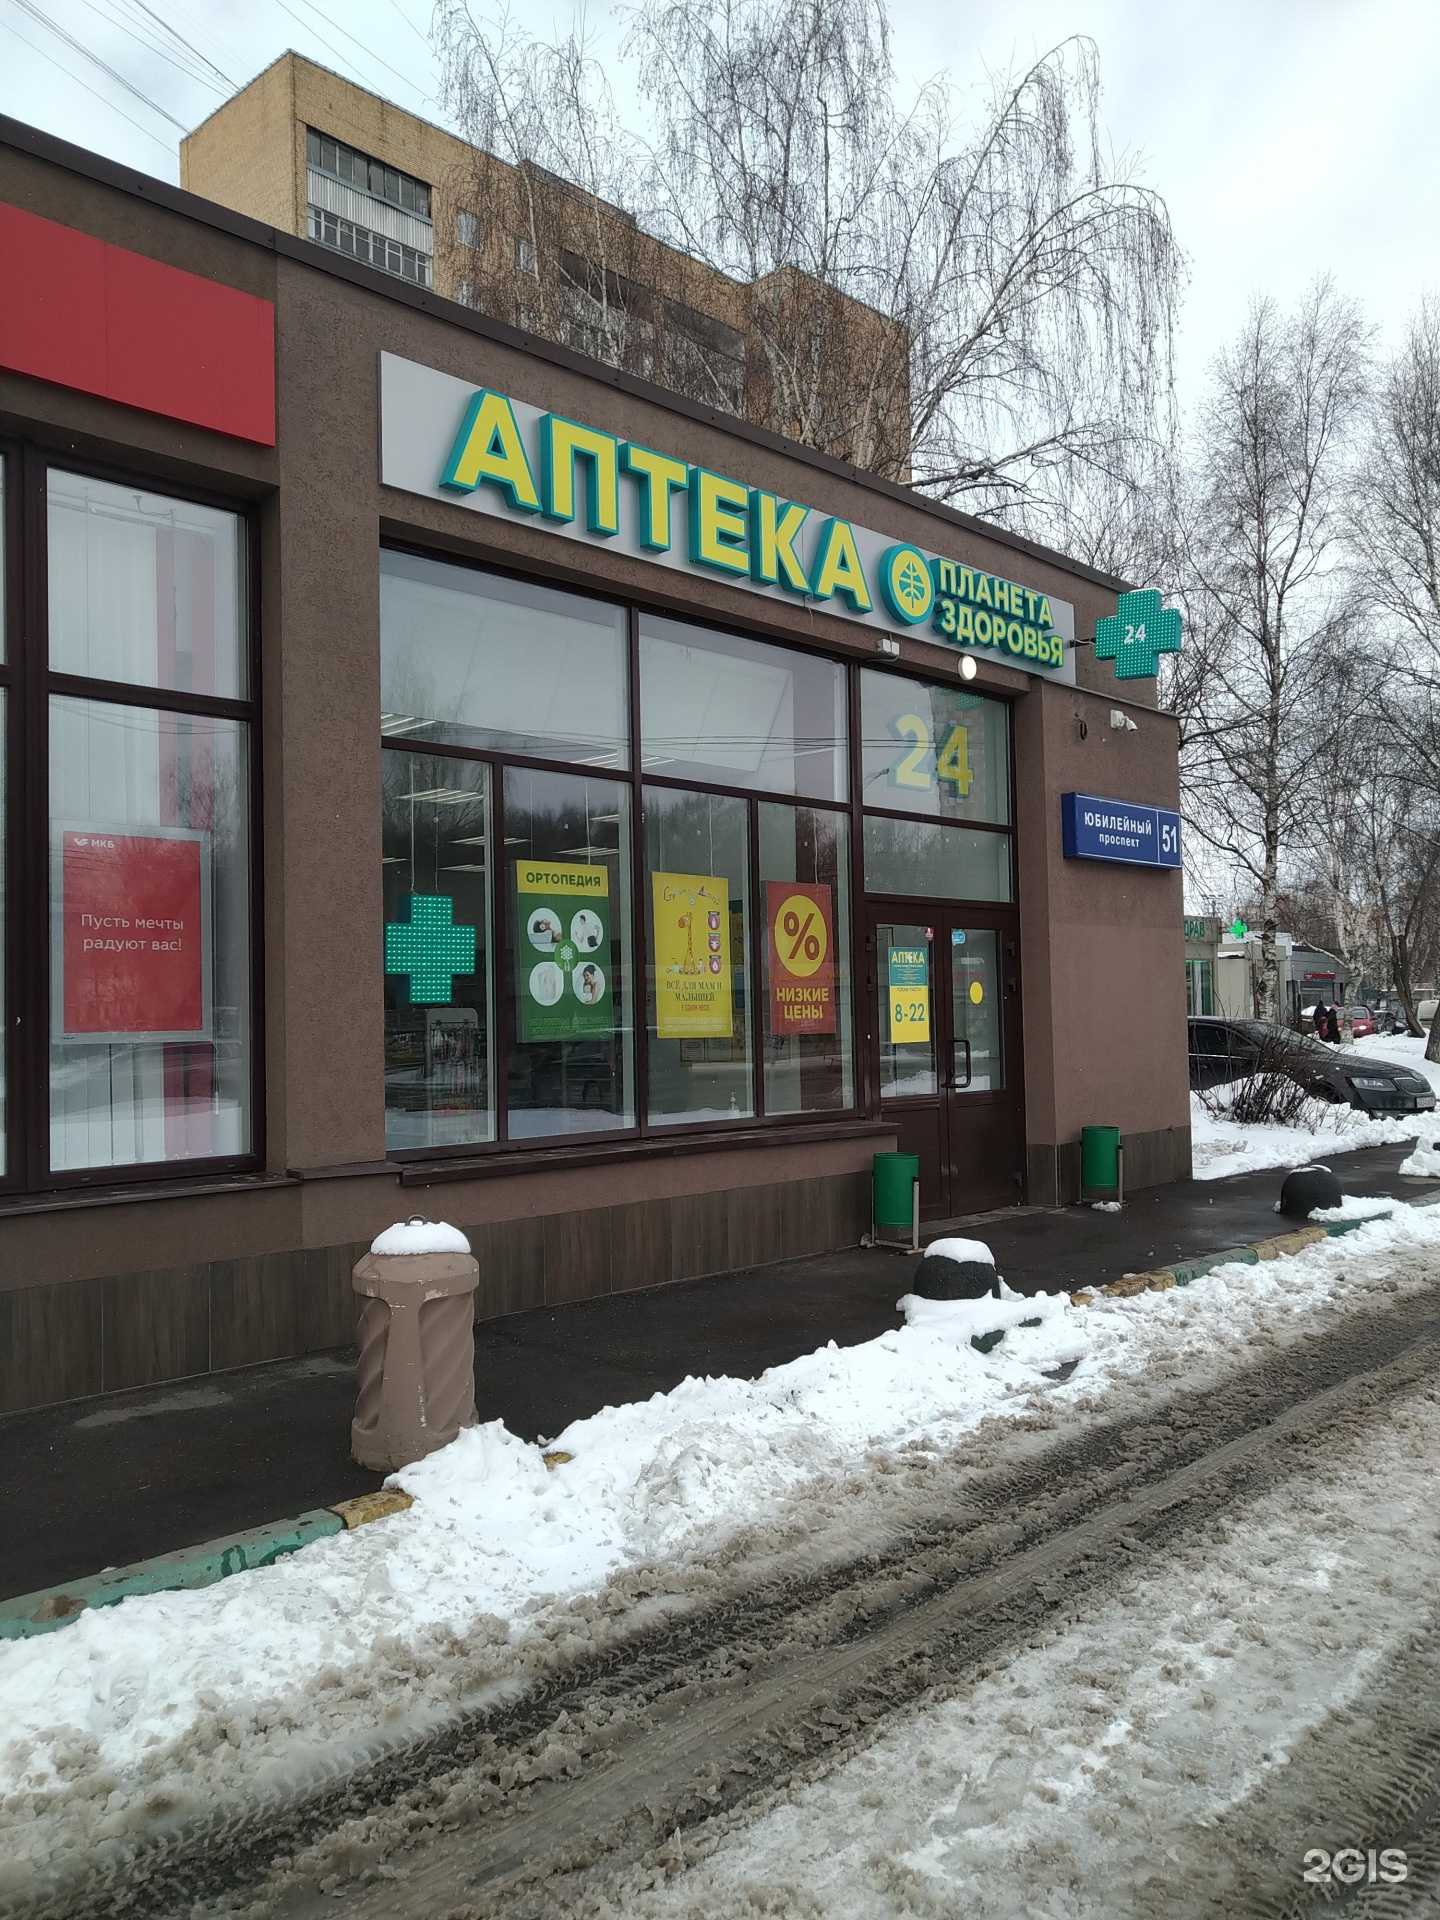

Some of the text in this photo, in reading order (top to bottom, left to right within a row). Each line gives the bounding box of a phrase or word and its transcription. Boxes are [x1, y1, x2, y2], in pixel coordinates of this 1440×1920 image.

[440, 388, 873, 614] АПТЕКА
[935, 557, 1055, 629] ПЛАНЕТА
[937, 599, 1064, 668] ЗДОРОВЬЯ
[1123, 623, 1147, 645] 24
[892, 712, 974, 798] 24
[1083, 810, 1178, 854] ЮБИЛЕЙНЫЙ 51
[1098, 833, 1140, 848] проспект
[90, 838, 115, 850] МКБ
[525, 871, 601, 888] ОРТОПЕДИЯ
[80, 913, 184, 931] Пусть мечты
[82, 936, 183, 952] радуют вас!
[776, 986, 830, 1002] НИЗКИЕ
[783, 1003, 824, 1022] ЦЕНЫ
[894, 1002, 927, 1023] 8-22
